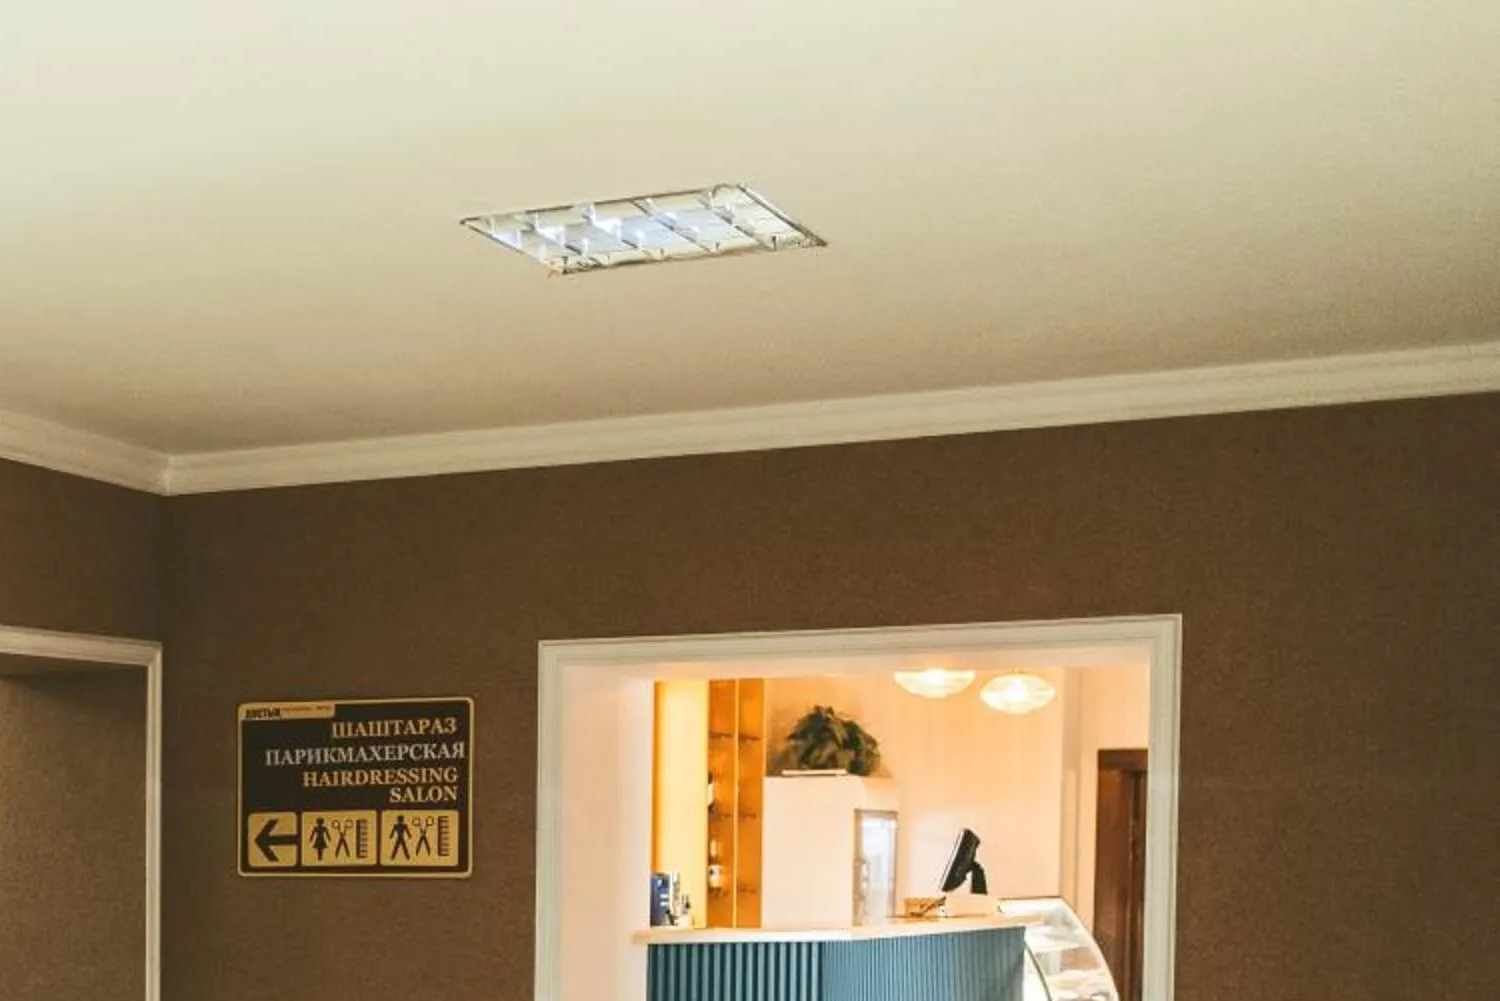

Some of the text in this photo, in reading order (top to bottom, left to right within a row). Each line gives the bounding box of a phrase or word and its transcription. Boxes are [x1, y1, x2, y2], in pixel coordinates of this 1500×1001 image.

[332, 717, 457, 738] ШАШТАРАЗ
[265, 742, 465, 766] ПАРИКМАХЕРСКАЯ
[303, 768, 457, 787] HAIRDRESSING
[389, 785, 457, 803] SALON
